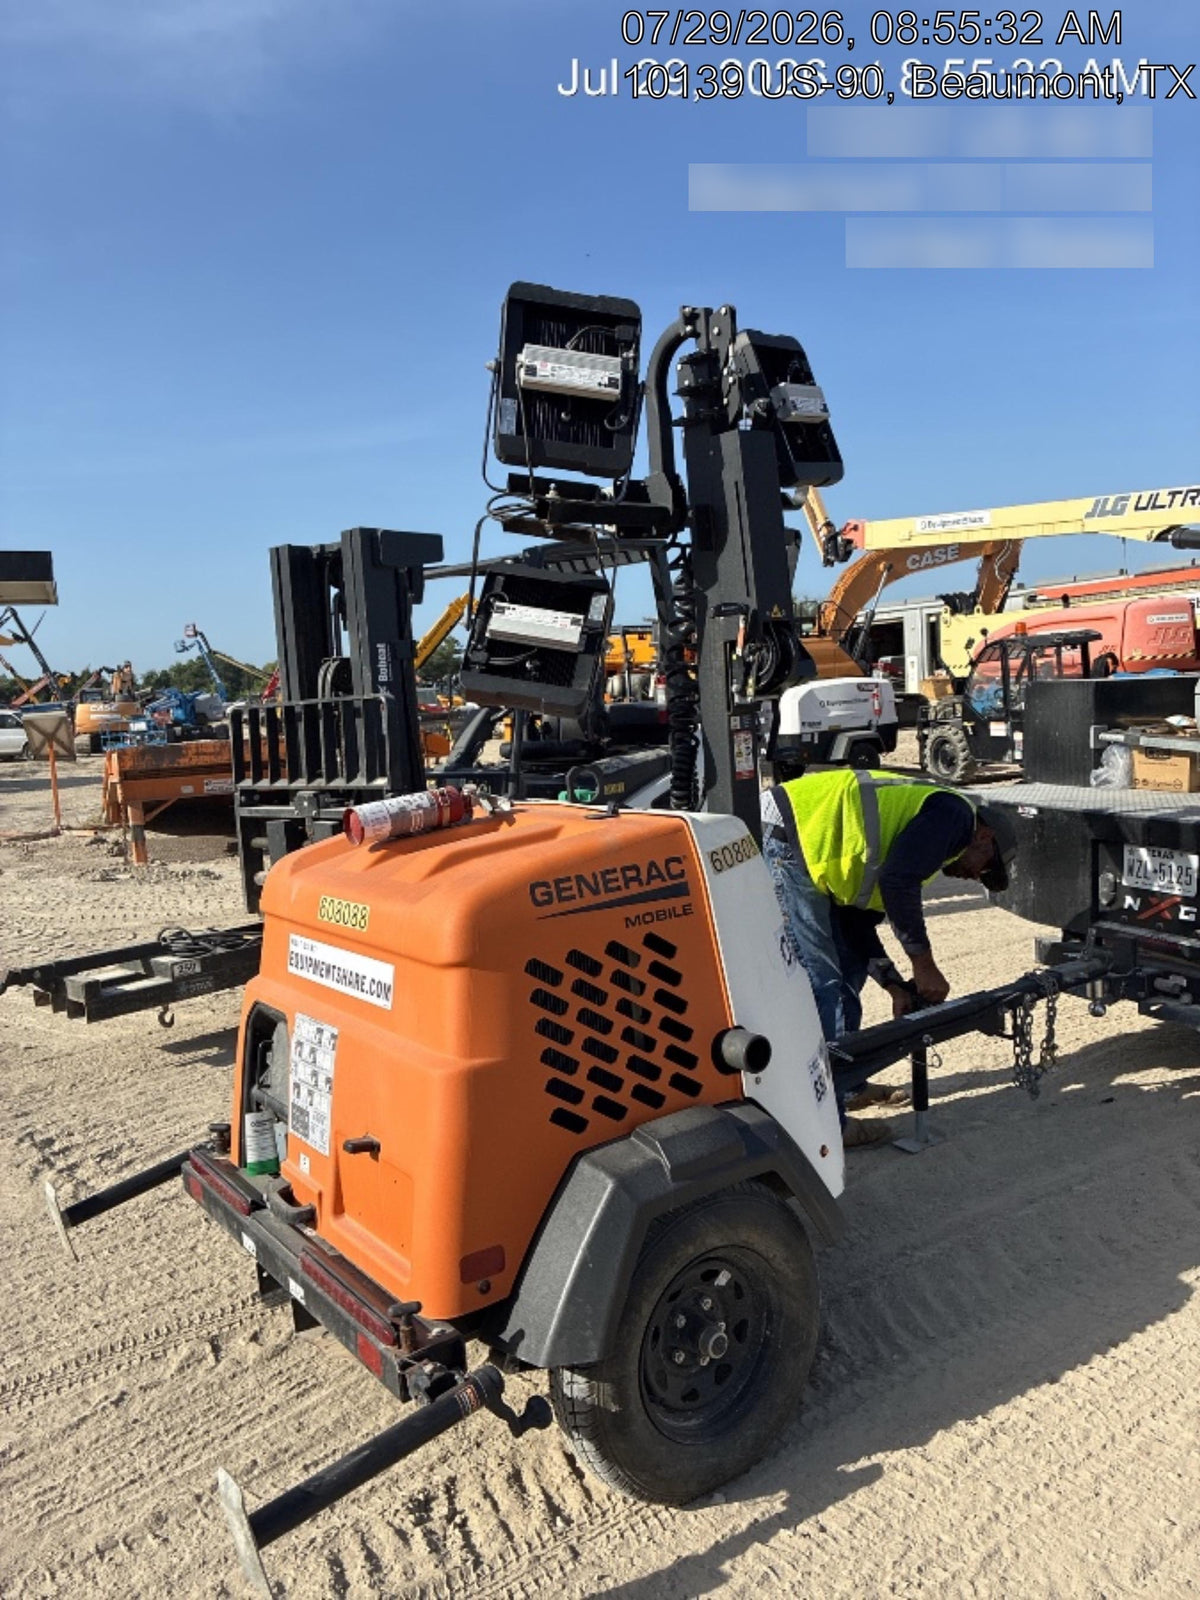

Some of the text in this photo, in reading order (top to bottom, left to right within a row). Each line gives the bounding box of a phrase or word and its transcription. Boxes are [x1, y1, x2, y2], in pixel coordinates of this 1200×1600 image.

[1084, 489, 1200, 519] JLG ULTR
[906, 543, 959, 570] CASE
[529, 855, 686, 907] GENERAC
[624, 903, 694, 929] MOBILE
